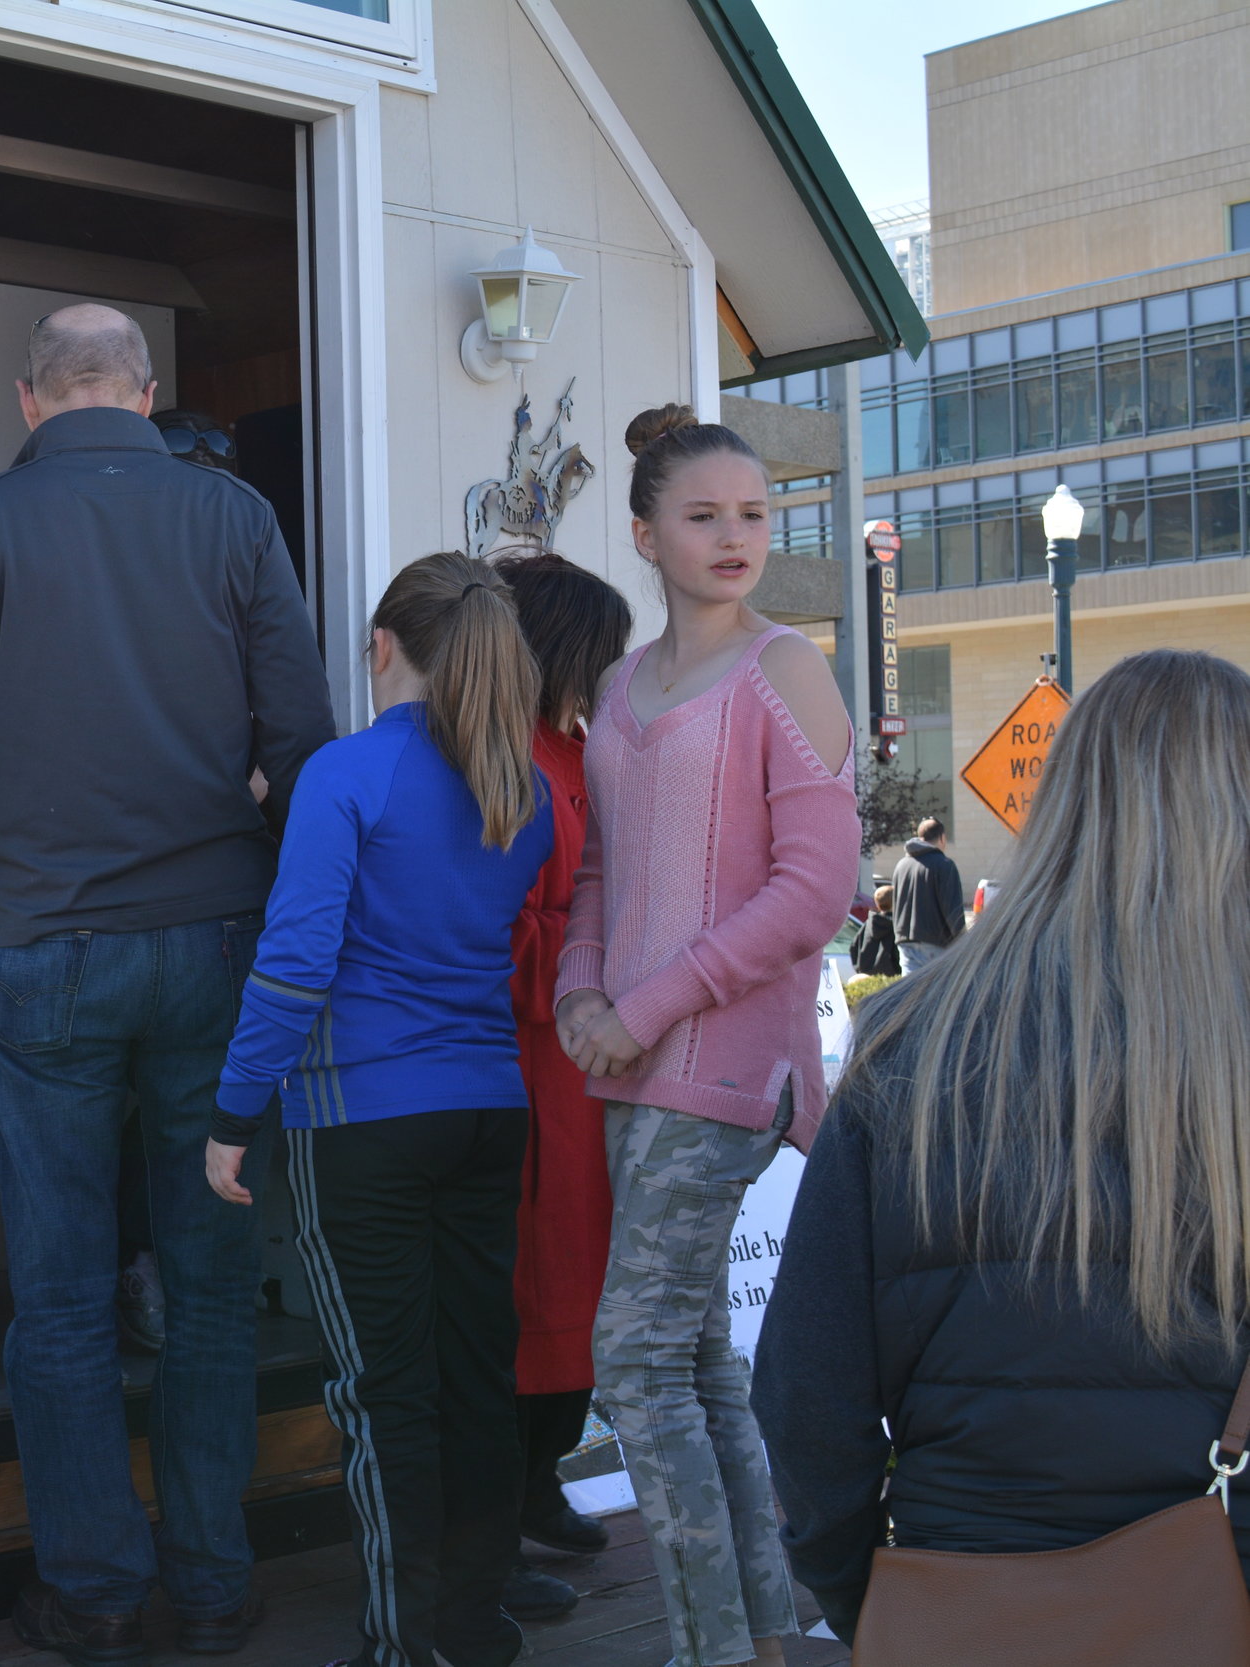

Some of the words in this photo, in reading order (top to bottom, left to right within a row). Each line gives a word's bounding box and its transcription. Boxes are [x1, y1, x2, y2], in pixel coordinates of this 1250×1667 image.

[884, 570, 897, 712] GARAGE
[1012, 722, 1056, 745] ROA
[1011, 756, 1042, 779] WO
[817, 1000, 834, 1018] ss
[745, 1281, 768, 1307] in
